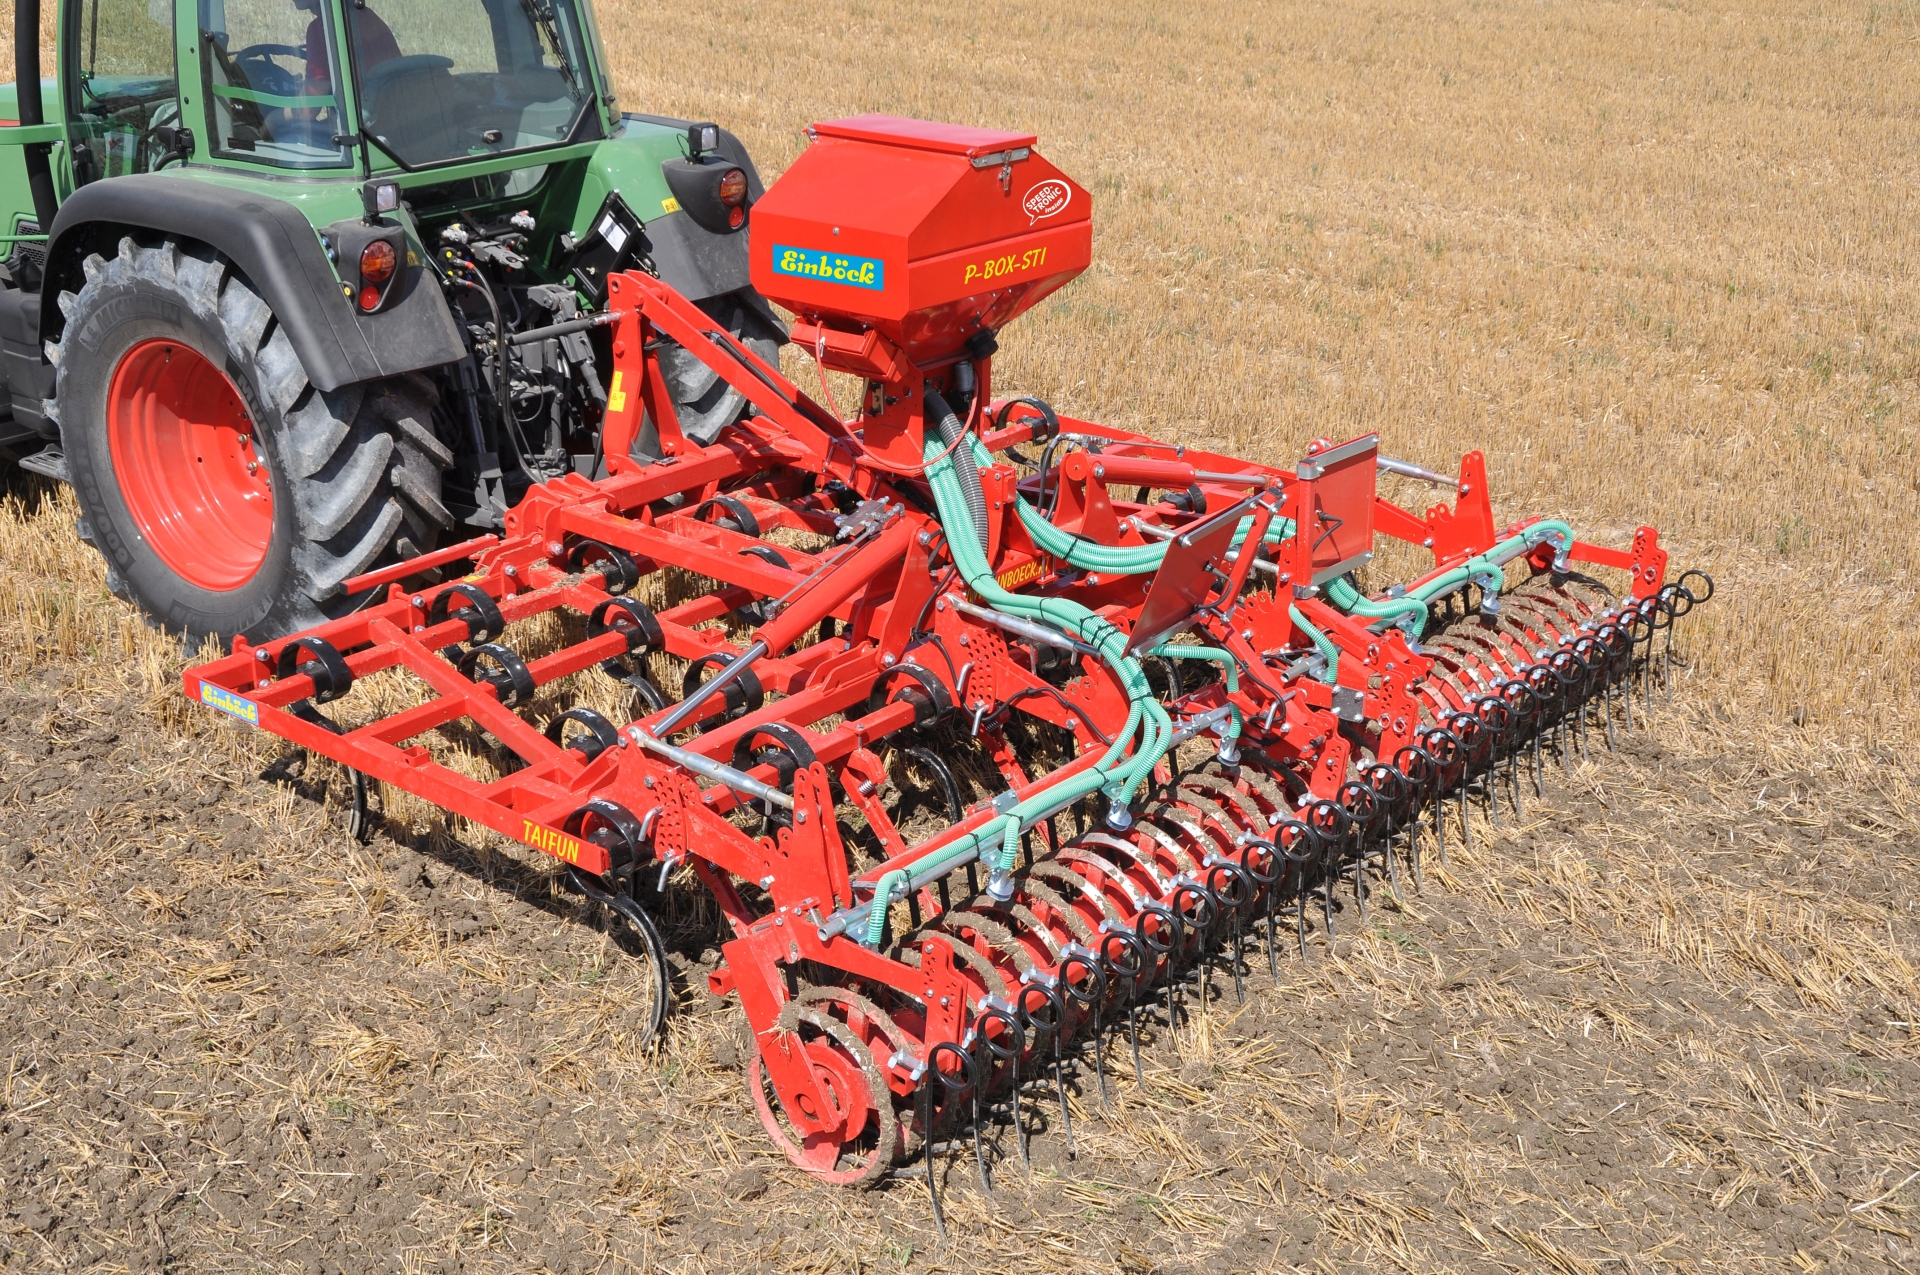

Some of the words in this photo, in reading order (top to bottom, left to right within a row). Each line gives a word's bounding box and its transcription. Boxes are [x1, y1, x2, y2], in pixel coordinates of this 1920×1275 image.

[1026, 186, 1053, 210] SPEED-
[1033, 187, 1062, 213] TRONIC
[1045, 197, 1063, 213] inside
[780, 250, 875, 285] Einböck
[963, 247, 1047, 285] P-BOX-STI
[81, 472, 129, 566] 600/65
[202, 684, 257, 722] Einböck
[523, 819, 580, 864] TAIFUN
